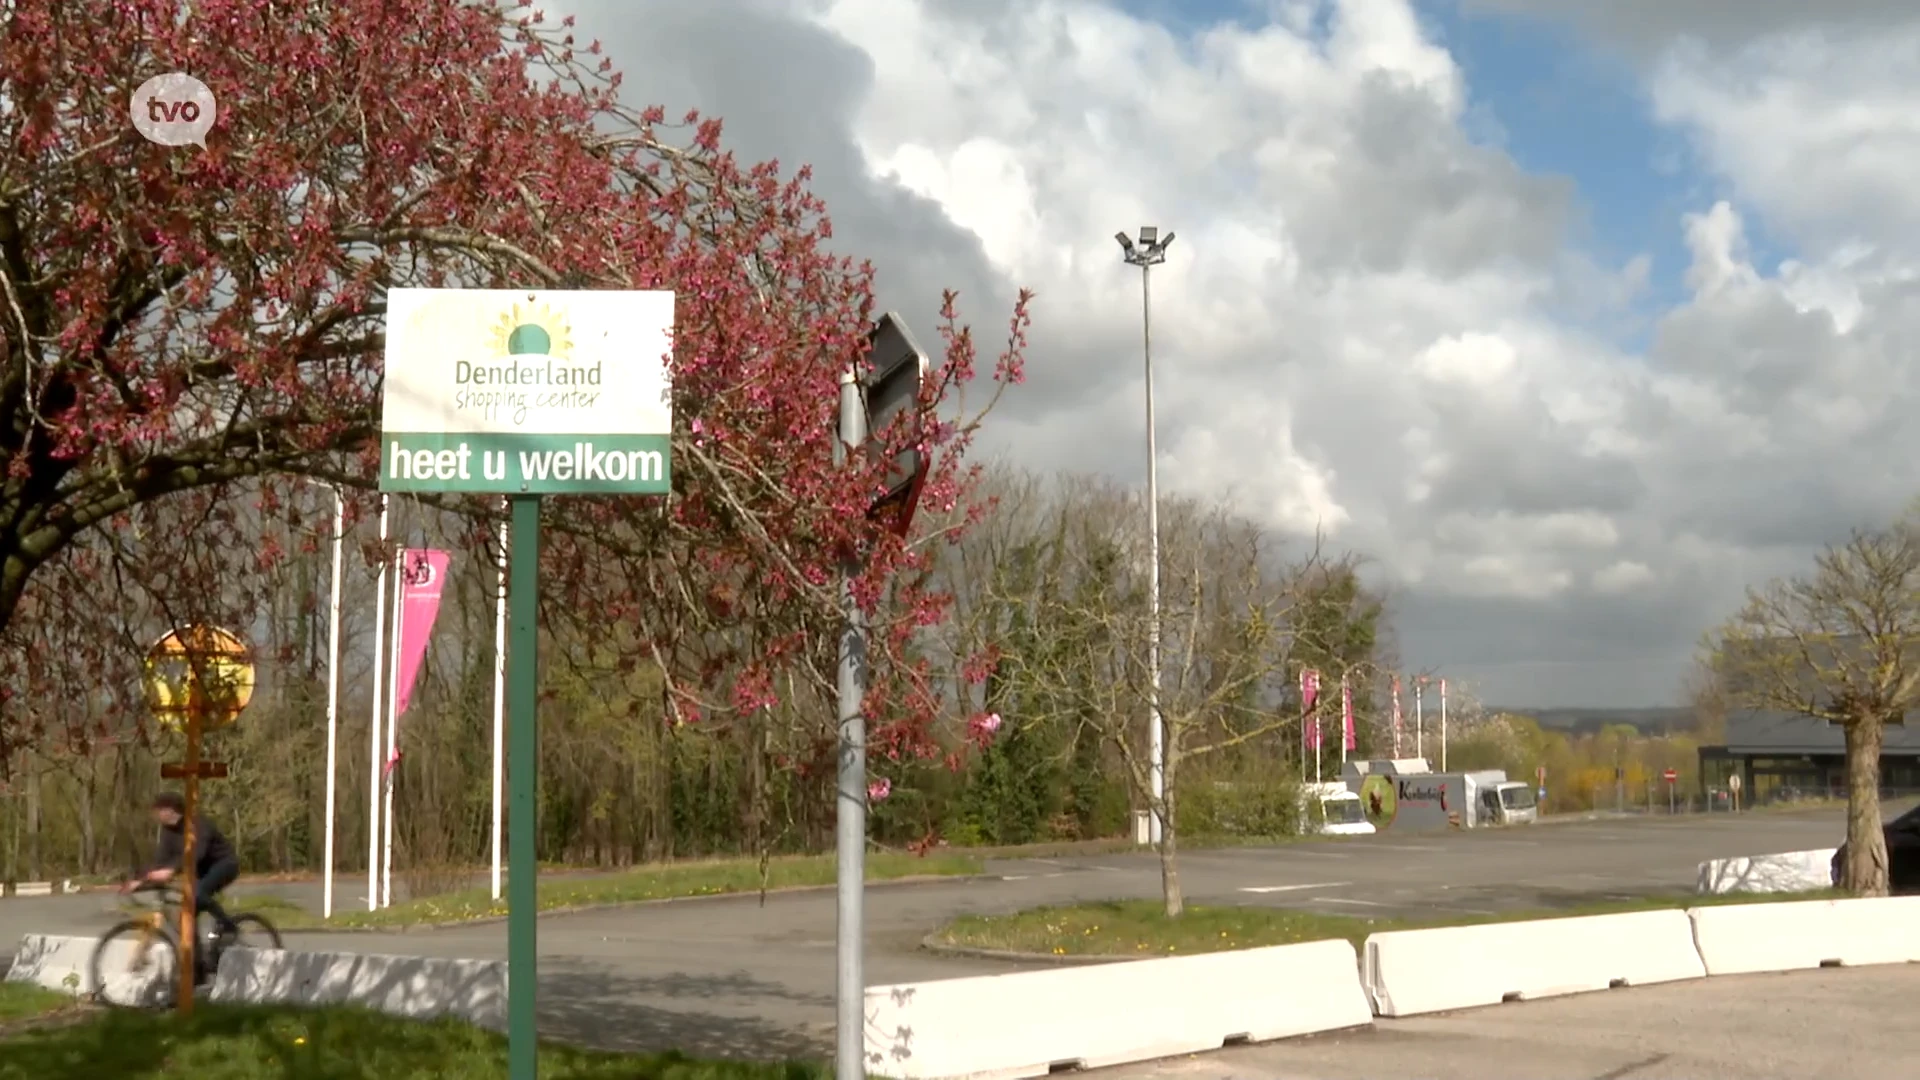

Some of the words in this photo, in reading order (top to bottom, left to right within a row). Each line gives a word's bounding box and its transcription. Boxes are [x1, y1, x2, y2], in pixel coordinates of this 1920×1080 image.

[456, 360, 602, 385] Denderland
[455, 386, 527, 425] shopping
[536, 387, 601, 409] center
[389, 441, 472, 480] heet
[483, 451, 506, 480] u
[520, 443, 663, 481] welkom
